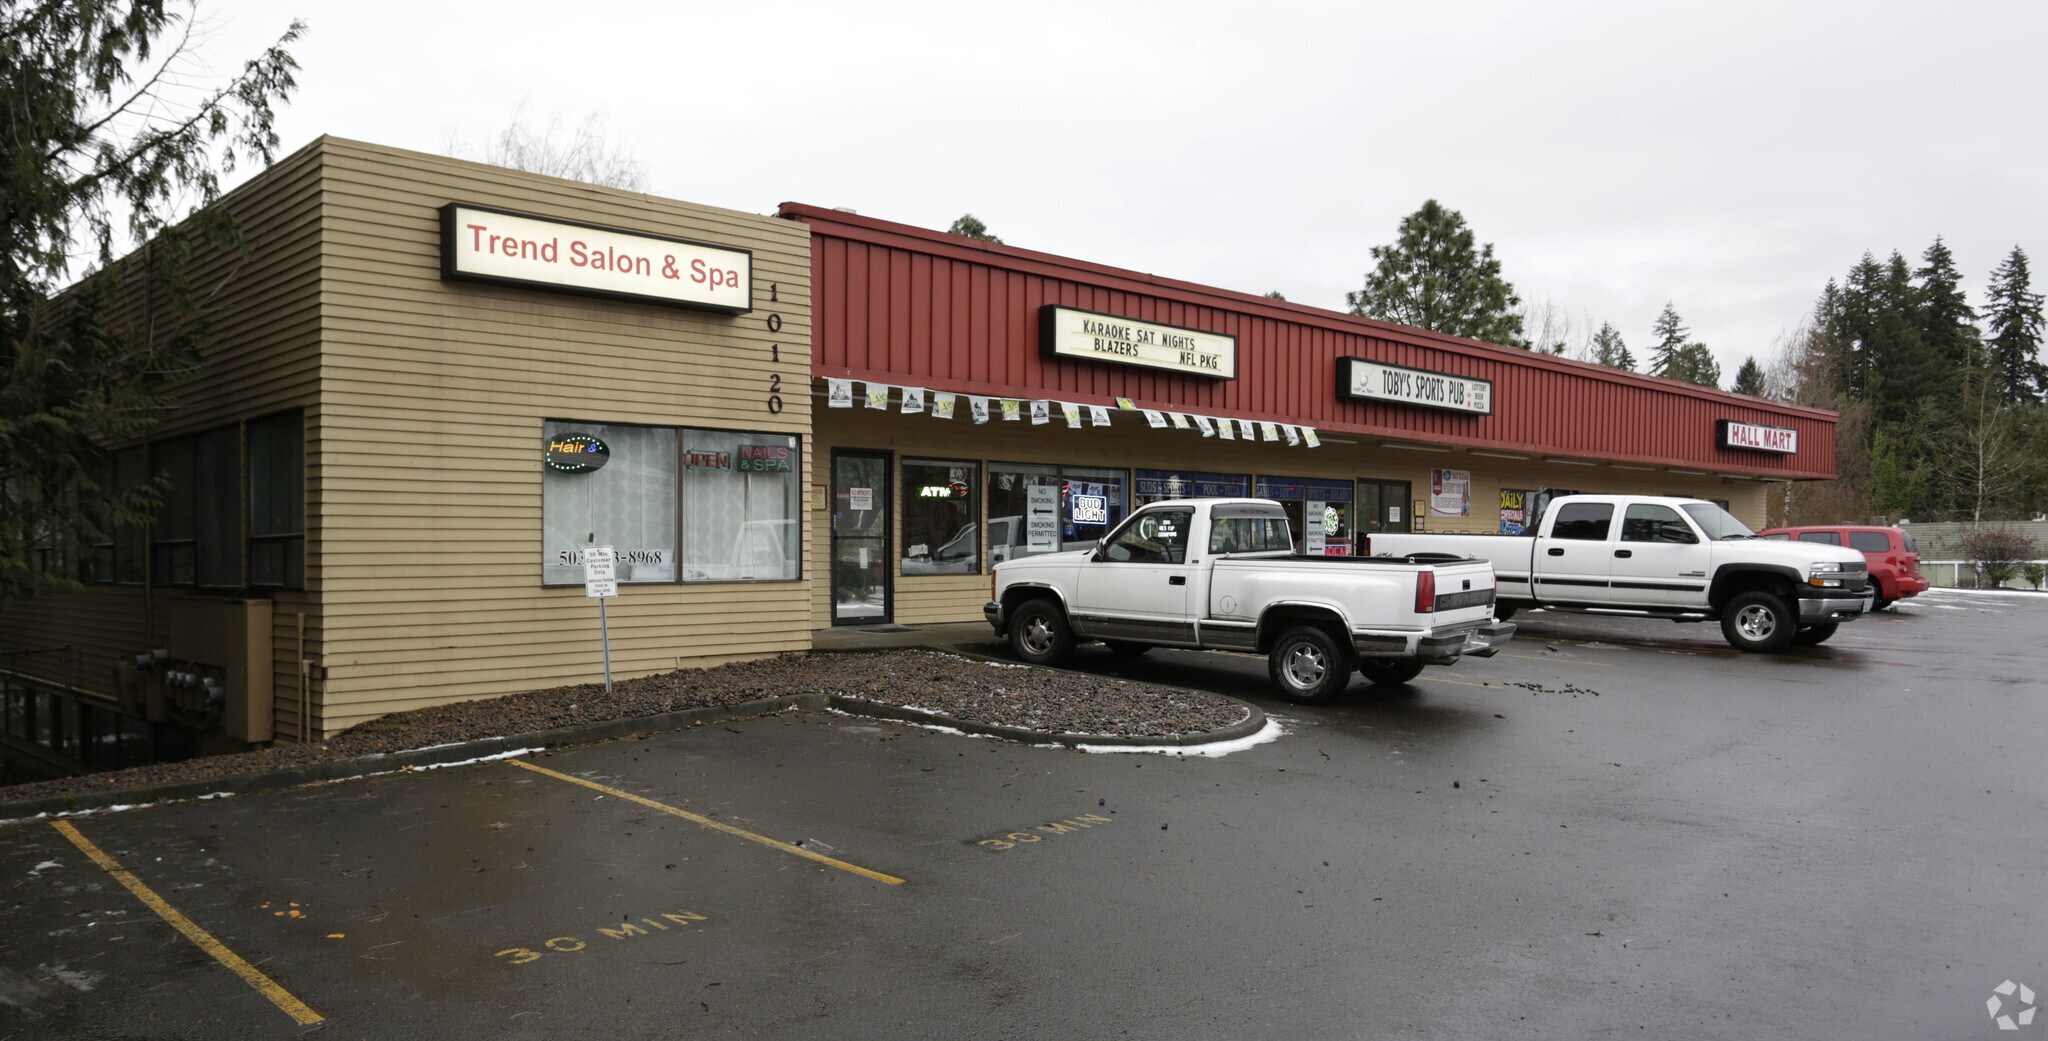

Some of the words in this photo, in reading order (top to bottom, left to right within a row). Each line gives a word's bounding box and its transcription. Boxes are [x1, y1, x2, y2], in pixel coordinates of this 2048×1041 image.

[467, 224, 558, 263] Trend
[569, 240, 651, 276] Salon
[661, 254, 680, 280] &
[690, 258, 739, 291] Spa
[1083, 319, 1131, 341] KARAOKE
[1137, 329, 1155, 344] SAT
[1162, 333, 1195, 350] NIGHTS
[1094, 339, 1139, 357] BLAZERS
[1179, 352, 1196, 366] NFL
[1200, 355, 1218, 370] PKG
[1382, 370, 1411, 397] TOBY'S
[1415, 375, 1444, 402] SPORTS
[1449, 381, 1465, 405] PUB
[1732, 424, 1760, 446] HALL
[1764, 429, 1792, 450] MART
[550, 440, 586, 453] Hair
[587, 443, 597, 453] &
[742, 447, 788, 459] NAILS
[683, 452, 729, 468] OPEN
[741, 460, 750, 470] &
[754, 459, 791, 471] SPA
[920, 486, 951, 497] ATM
[1140, 481, 1157, 493] SUDS
[1163, 482, 1186, 494] SPORTS
[1203, 484, 1218, 495] POOL
[1079, 497, 1102, 509] BUD
[1074, 508, 1105, 522] LIGHT
[978, 832, 1042, 850] 30
[1036, 813, 1112, 835] MIN
[495, 936, 587, 964] 30
[596, 909, 708, 940] MIN
